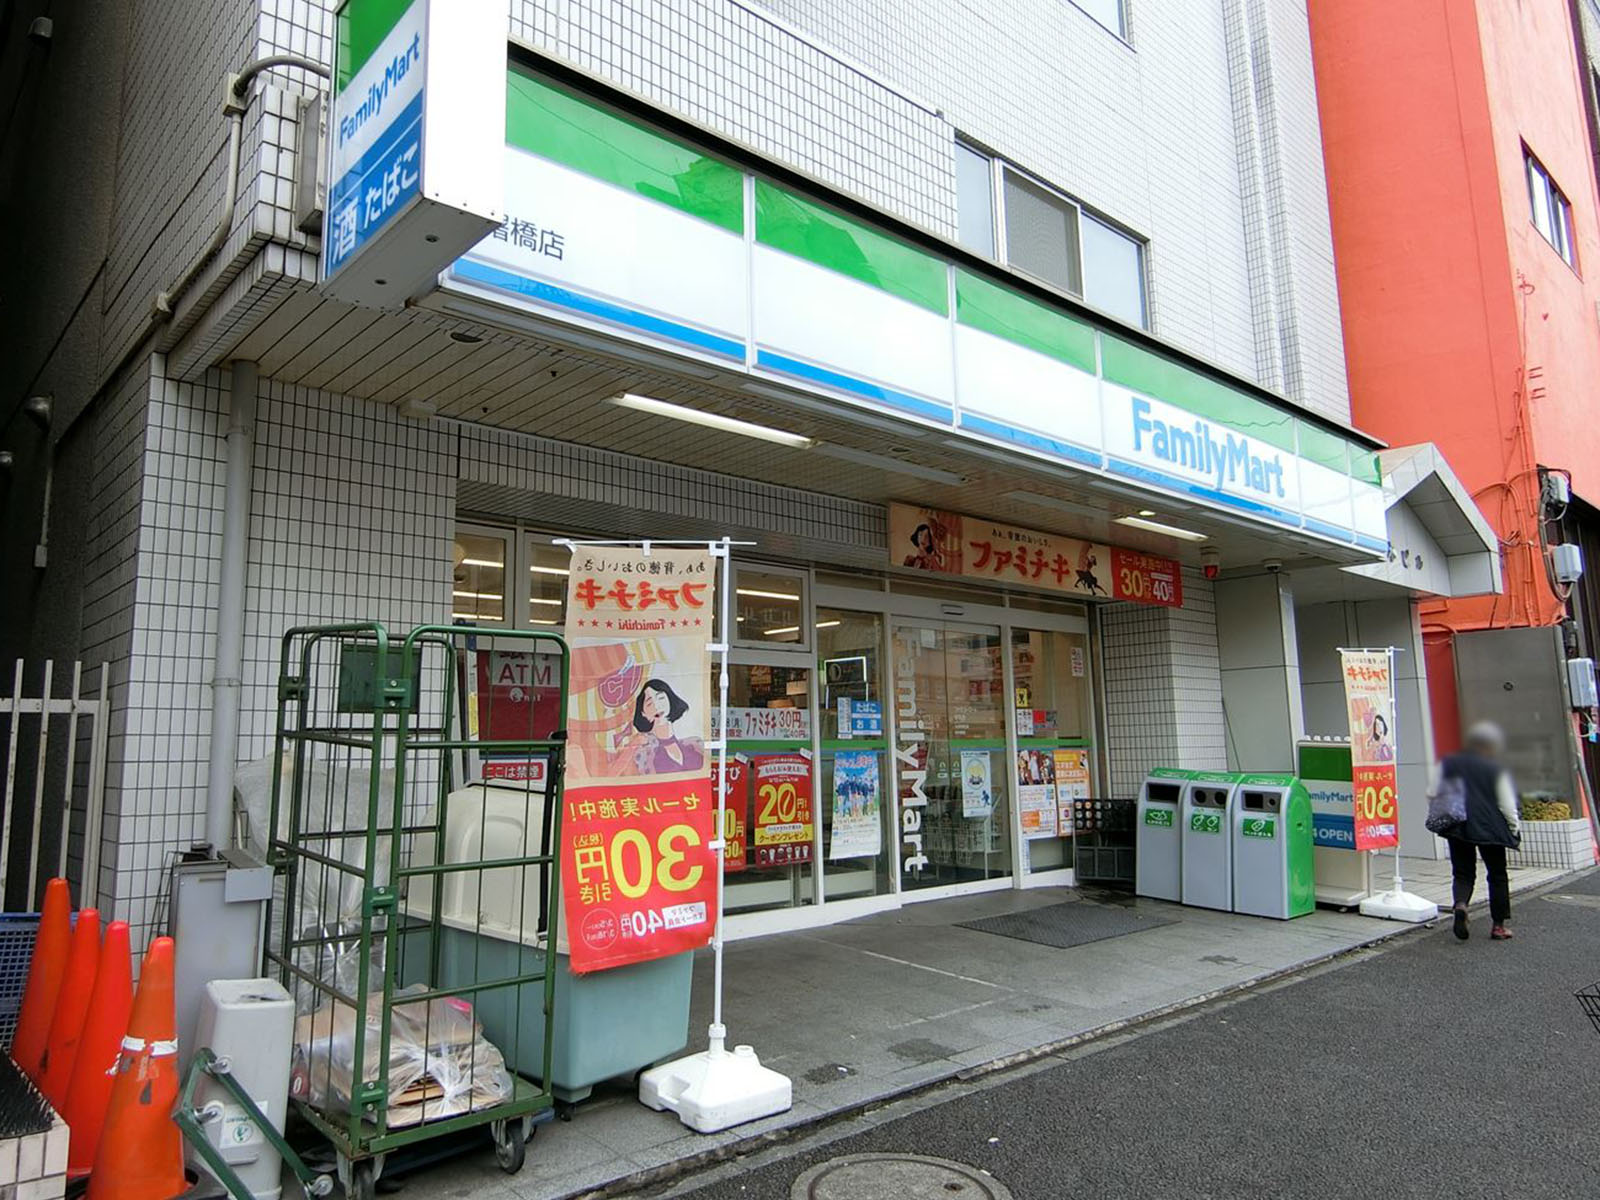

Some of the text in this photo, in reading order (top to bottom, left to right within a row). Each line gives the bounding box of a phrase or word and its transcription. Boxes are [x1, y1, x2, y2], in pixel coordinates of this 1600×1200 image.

[339, 31, 421, 149] FamilyMart
[331, 141, 419, 264] 酒 たばこ
[1131, 396, 1285, 498] FamilyMart
[969, 540, 1071, 584] ファミチキ
[1120, 567, 1144, 598] 30
[498, 663, 551, 685] ATM
[895, 634, 930, 873] FamilyMart
[758, 783, 796, 824] 20
[1318, 829, 1353, 842] OPEN
